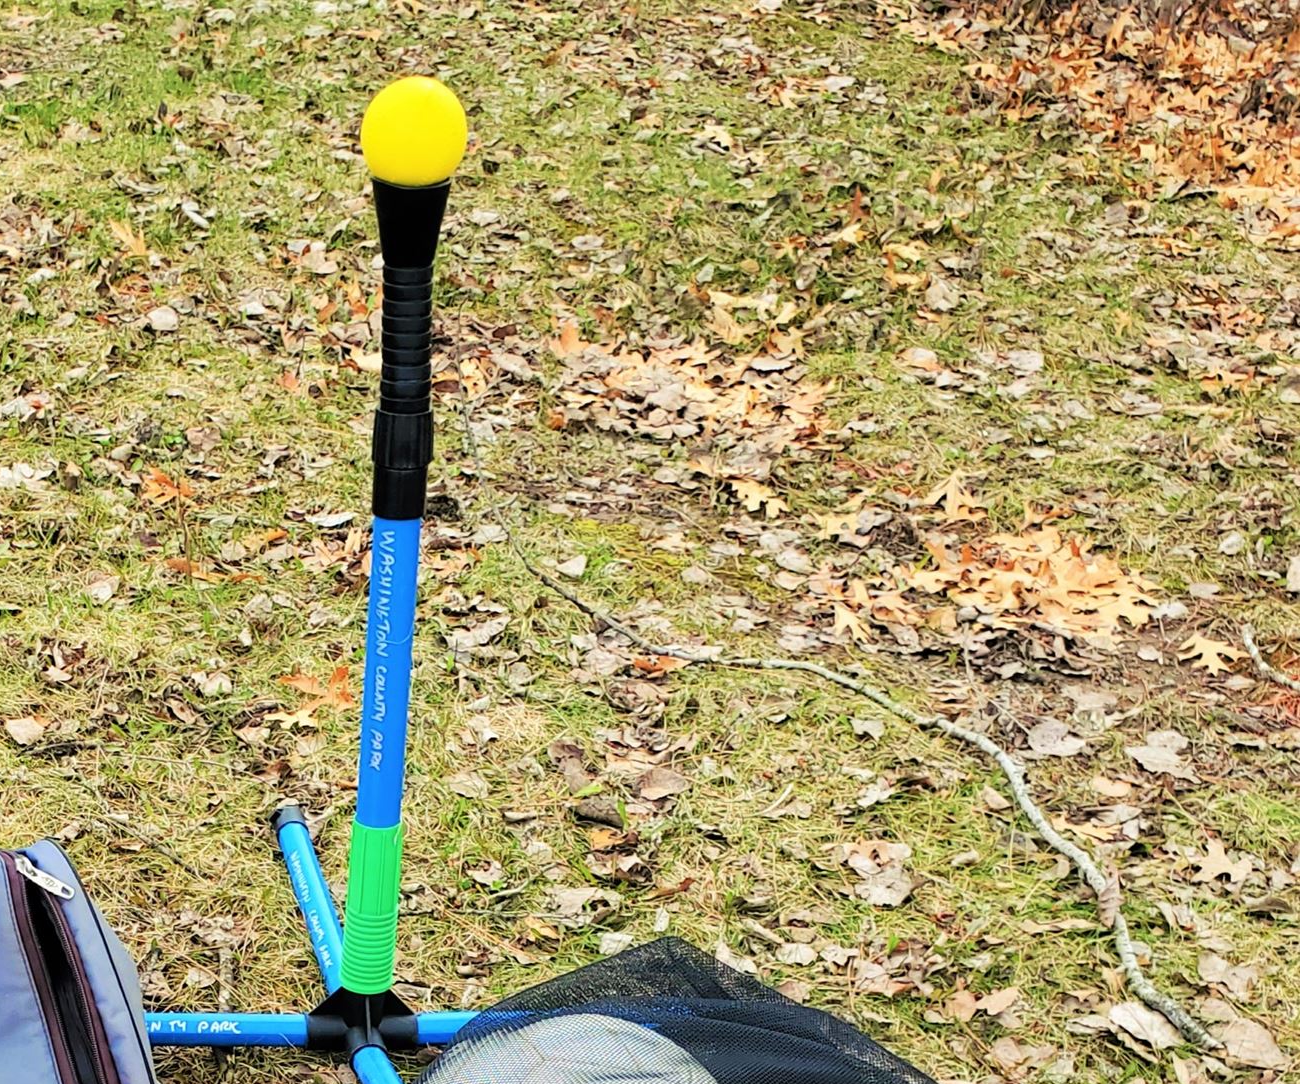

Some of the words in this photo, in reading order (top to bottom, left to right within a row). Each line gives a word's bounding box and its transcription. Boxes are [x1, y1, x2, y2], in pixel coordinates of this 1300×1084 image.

[375, 530, 396, 657] WASHINGTON
[371, 666, 388, 722] COUNTY
[369, 729, 384, 771] PARK
[146, 1020, 187, 1033] NTY
[197, 1020, 241, 1034] PARK
